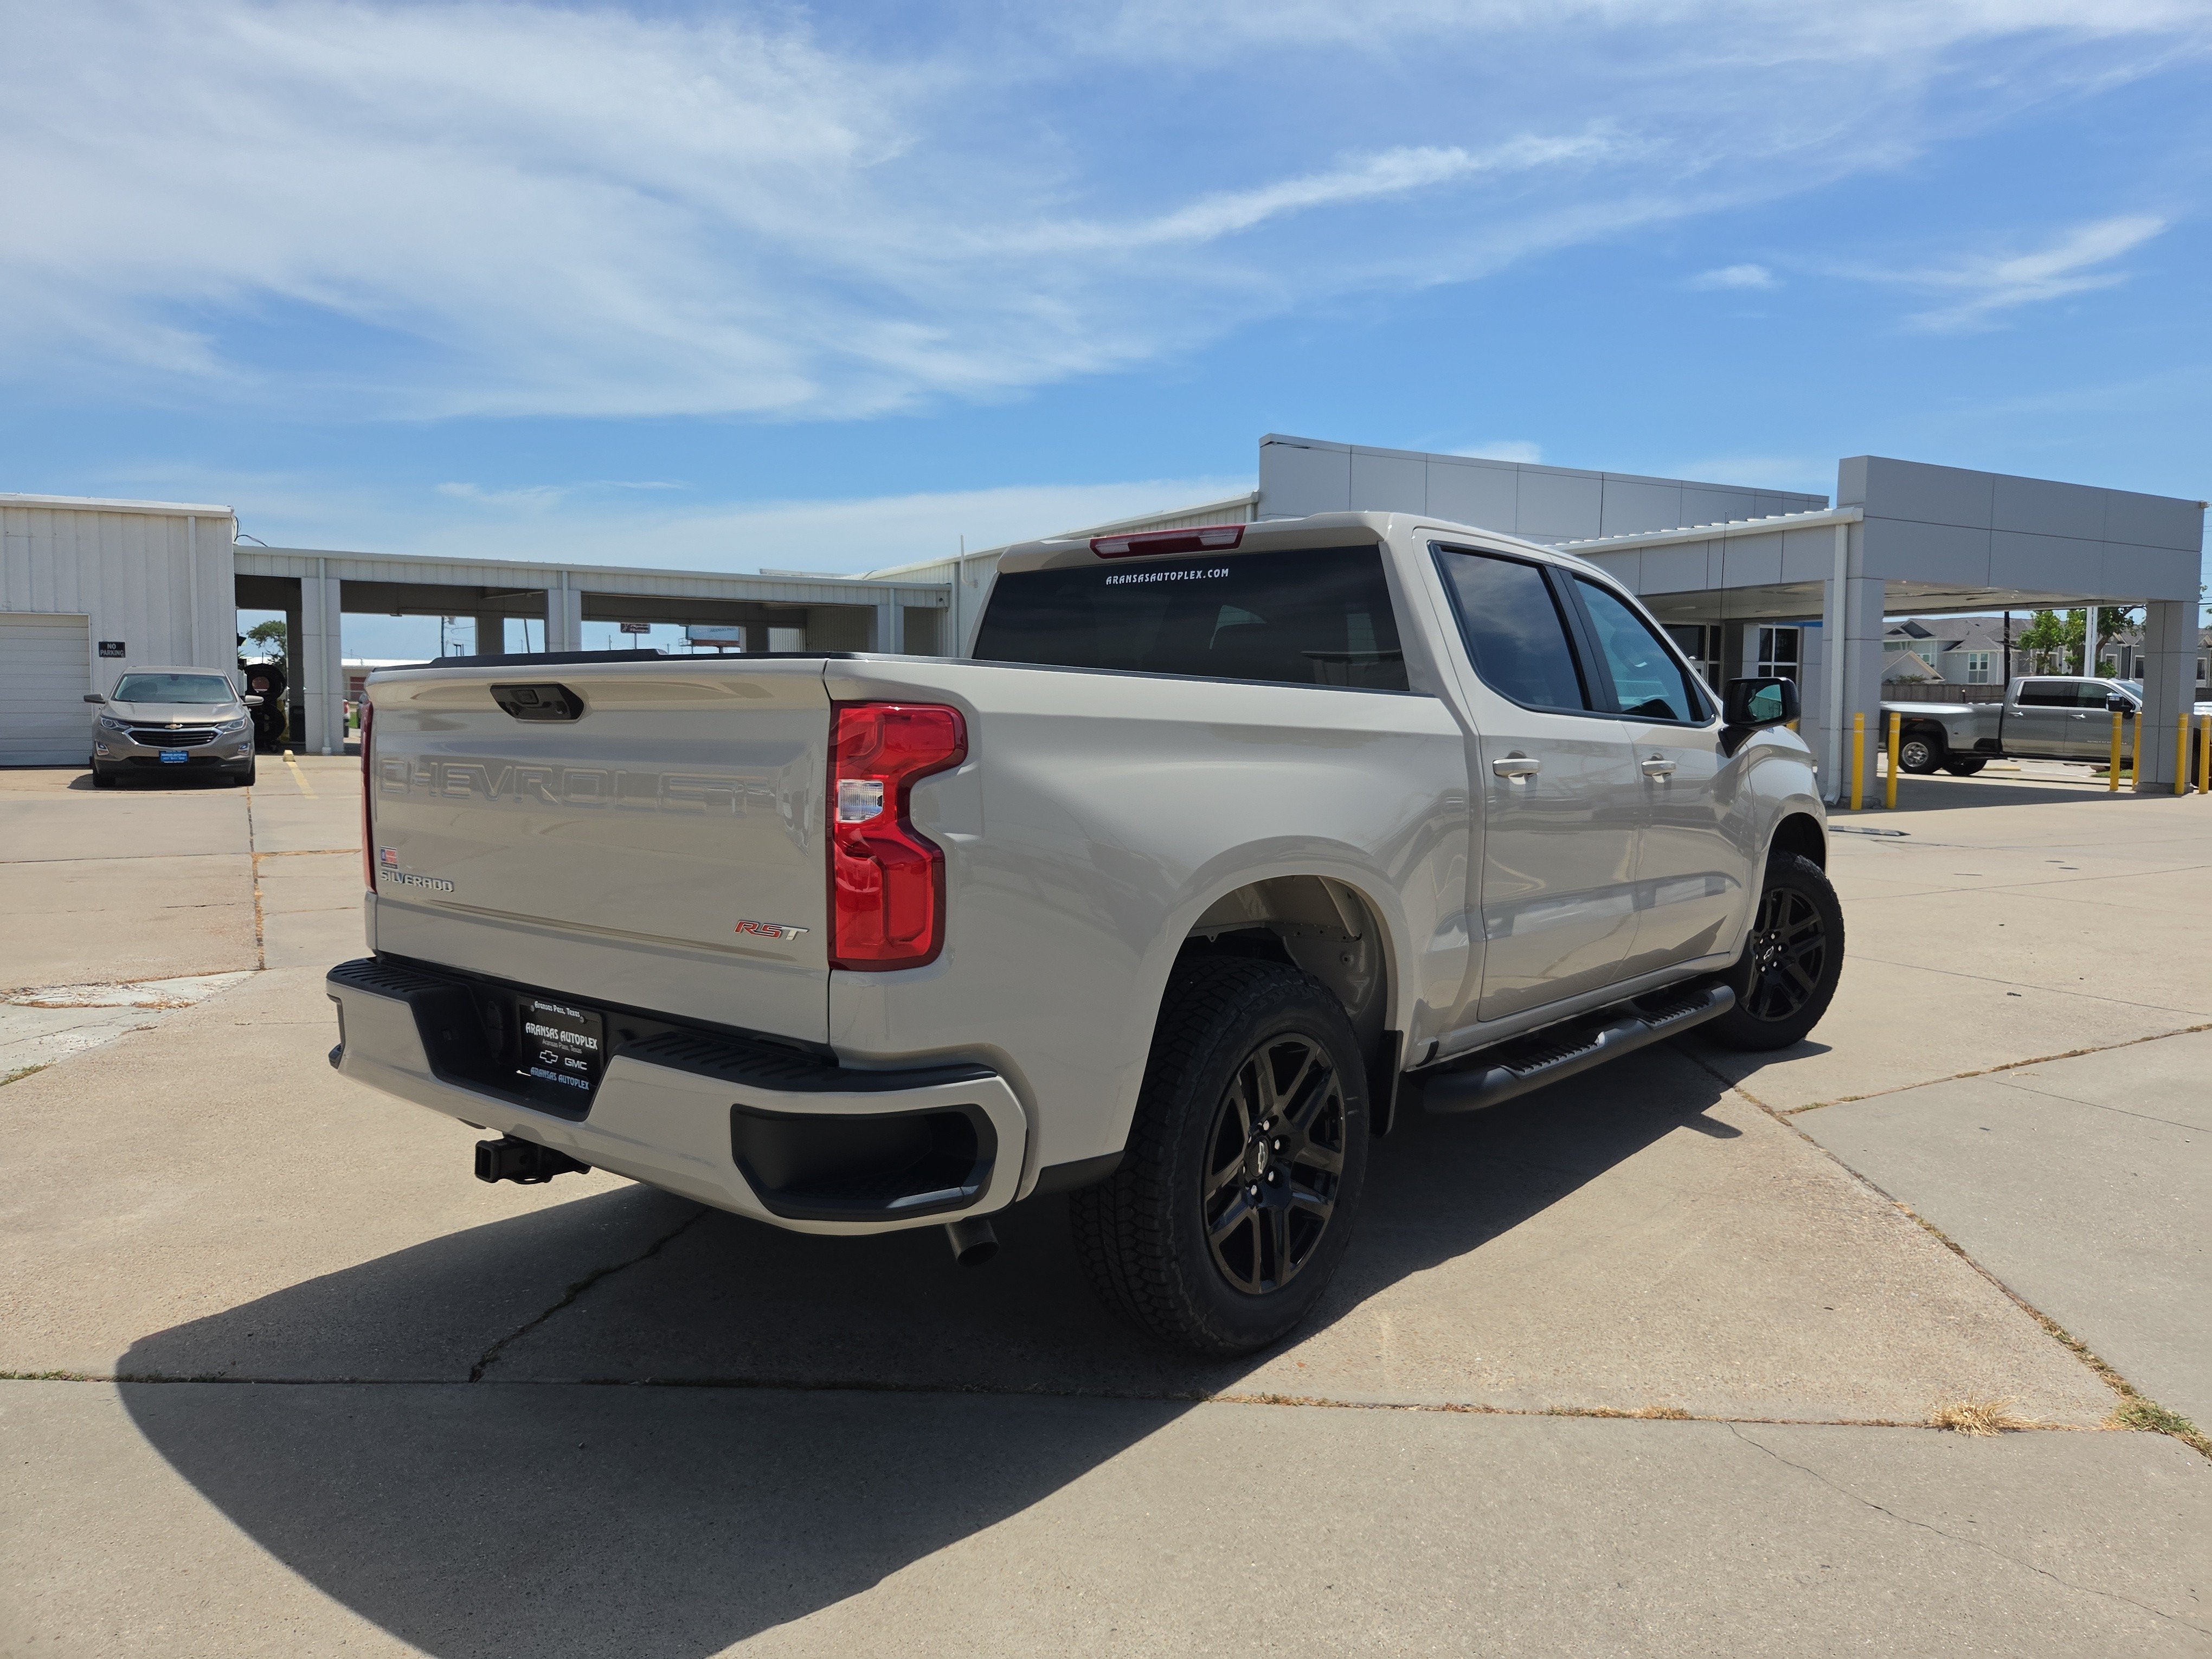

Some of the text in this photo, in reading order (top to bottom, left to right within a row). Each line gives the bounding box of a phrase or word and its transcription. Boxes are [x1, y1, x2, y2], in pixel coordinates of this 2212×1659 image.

[1105, 568, 1229, 585] ARANSASAUTOPLEX.COM
[381, 760, 773, 818] CHEVROLET
[380, 870, 454, 892] SILVERADO
[734, 920, 811, 941] RST
[535, 1001, 552, 1012] Aransas
[566, 1007, 580, 1018] Texas
[525, 1023, 598, 1050] ARANSAS AUTOPLEX
[542, 1039, 558, 1048] Aransas
[570, 1045, 583, 1054] Texas
[564, 1057, 587, 1070] GMC
[530, 1066, 589, 1090] ARANSAS AUTOPLEX
